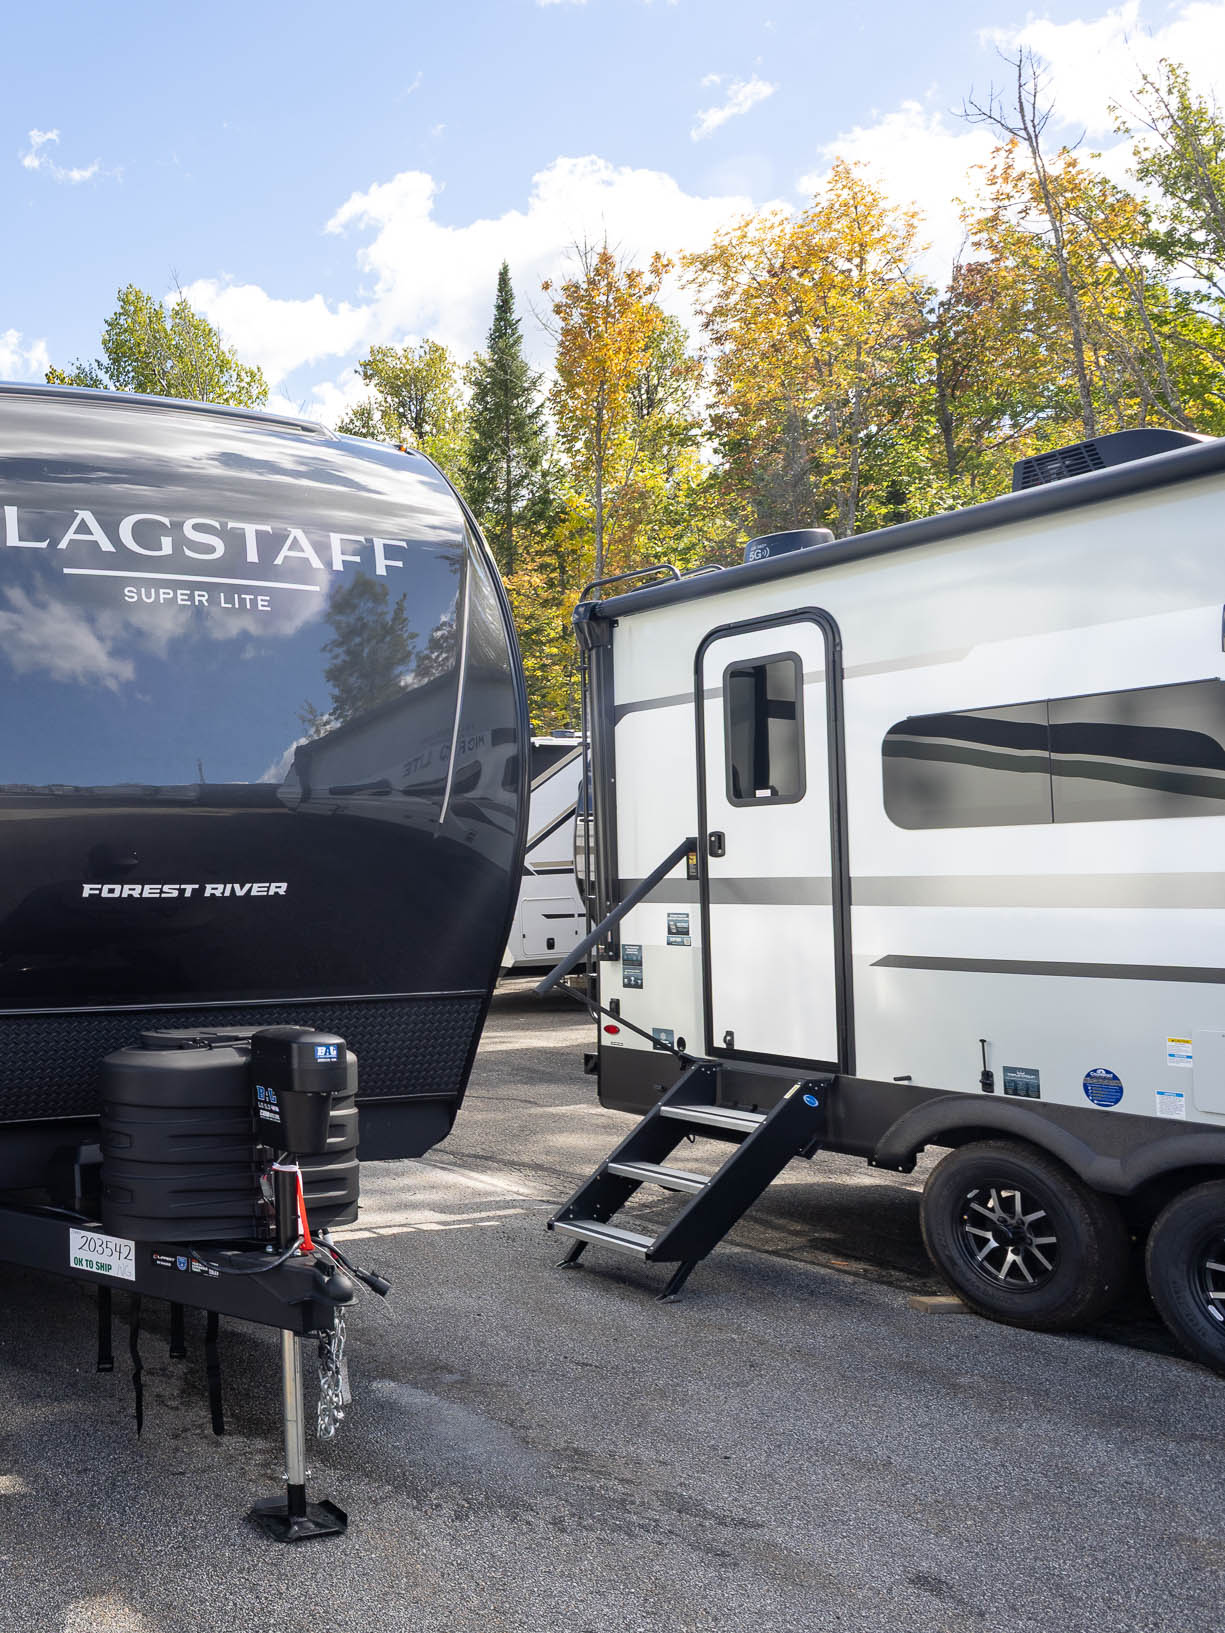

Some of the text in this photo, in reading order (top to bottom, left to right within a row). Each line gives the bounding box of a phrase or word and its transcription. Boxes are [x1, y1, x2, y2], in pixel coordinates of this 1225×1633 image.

[123, 586, 272, 611] SUPER LITE
[81, 882, 288, 898] FOREST RIVER
[78, 1235, 133, 1261] 203542
[73, 1256, 113, 1273] OK TO SHIP
